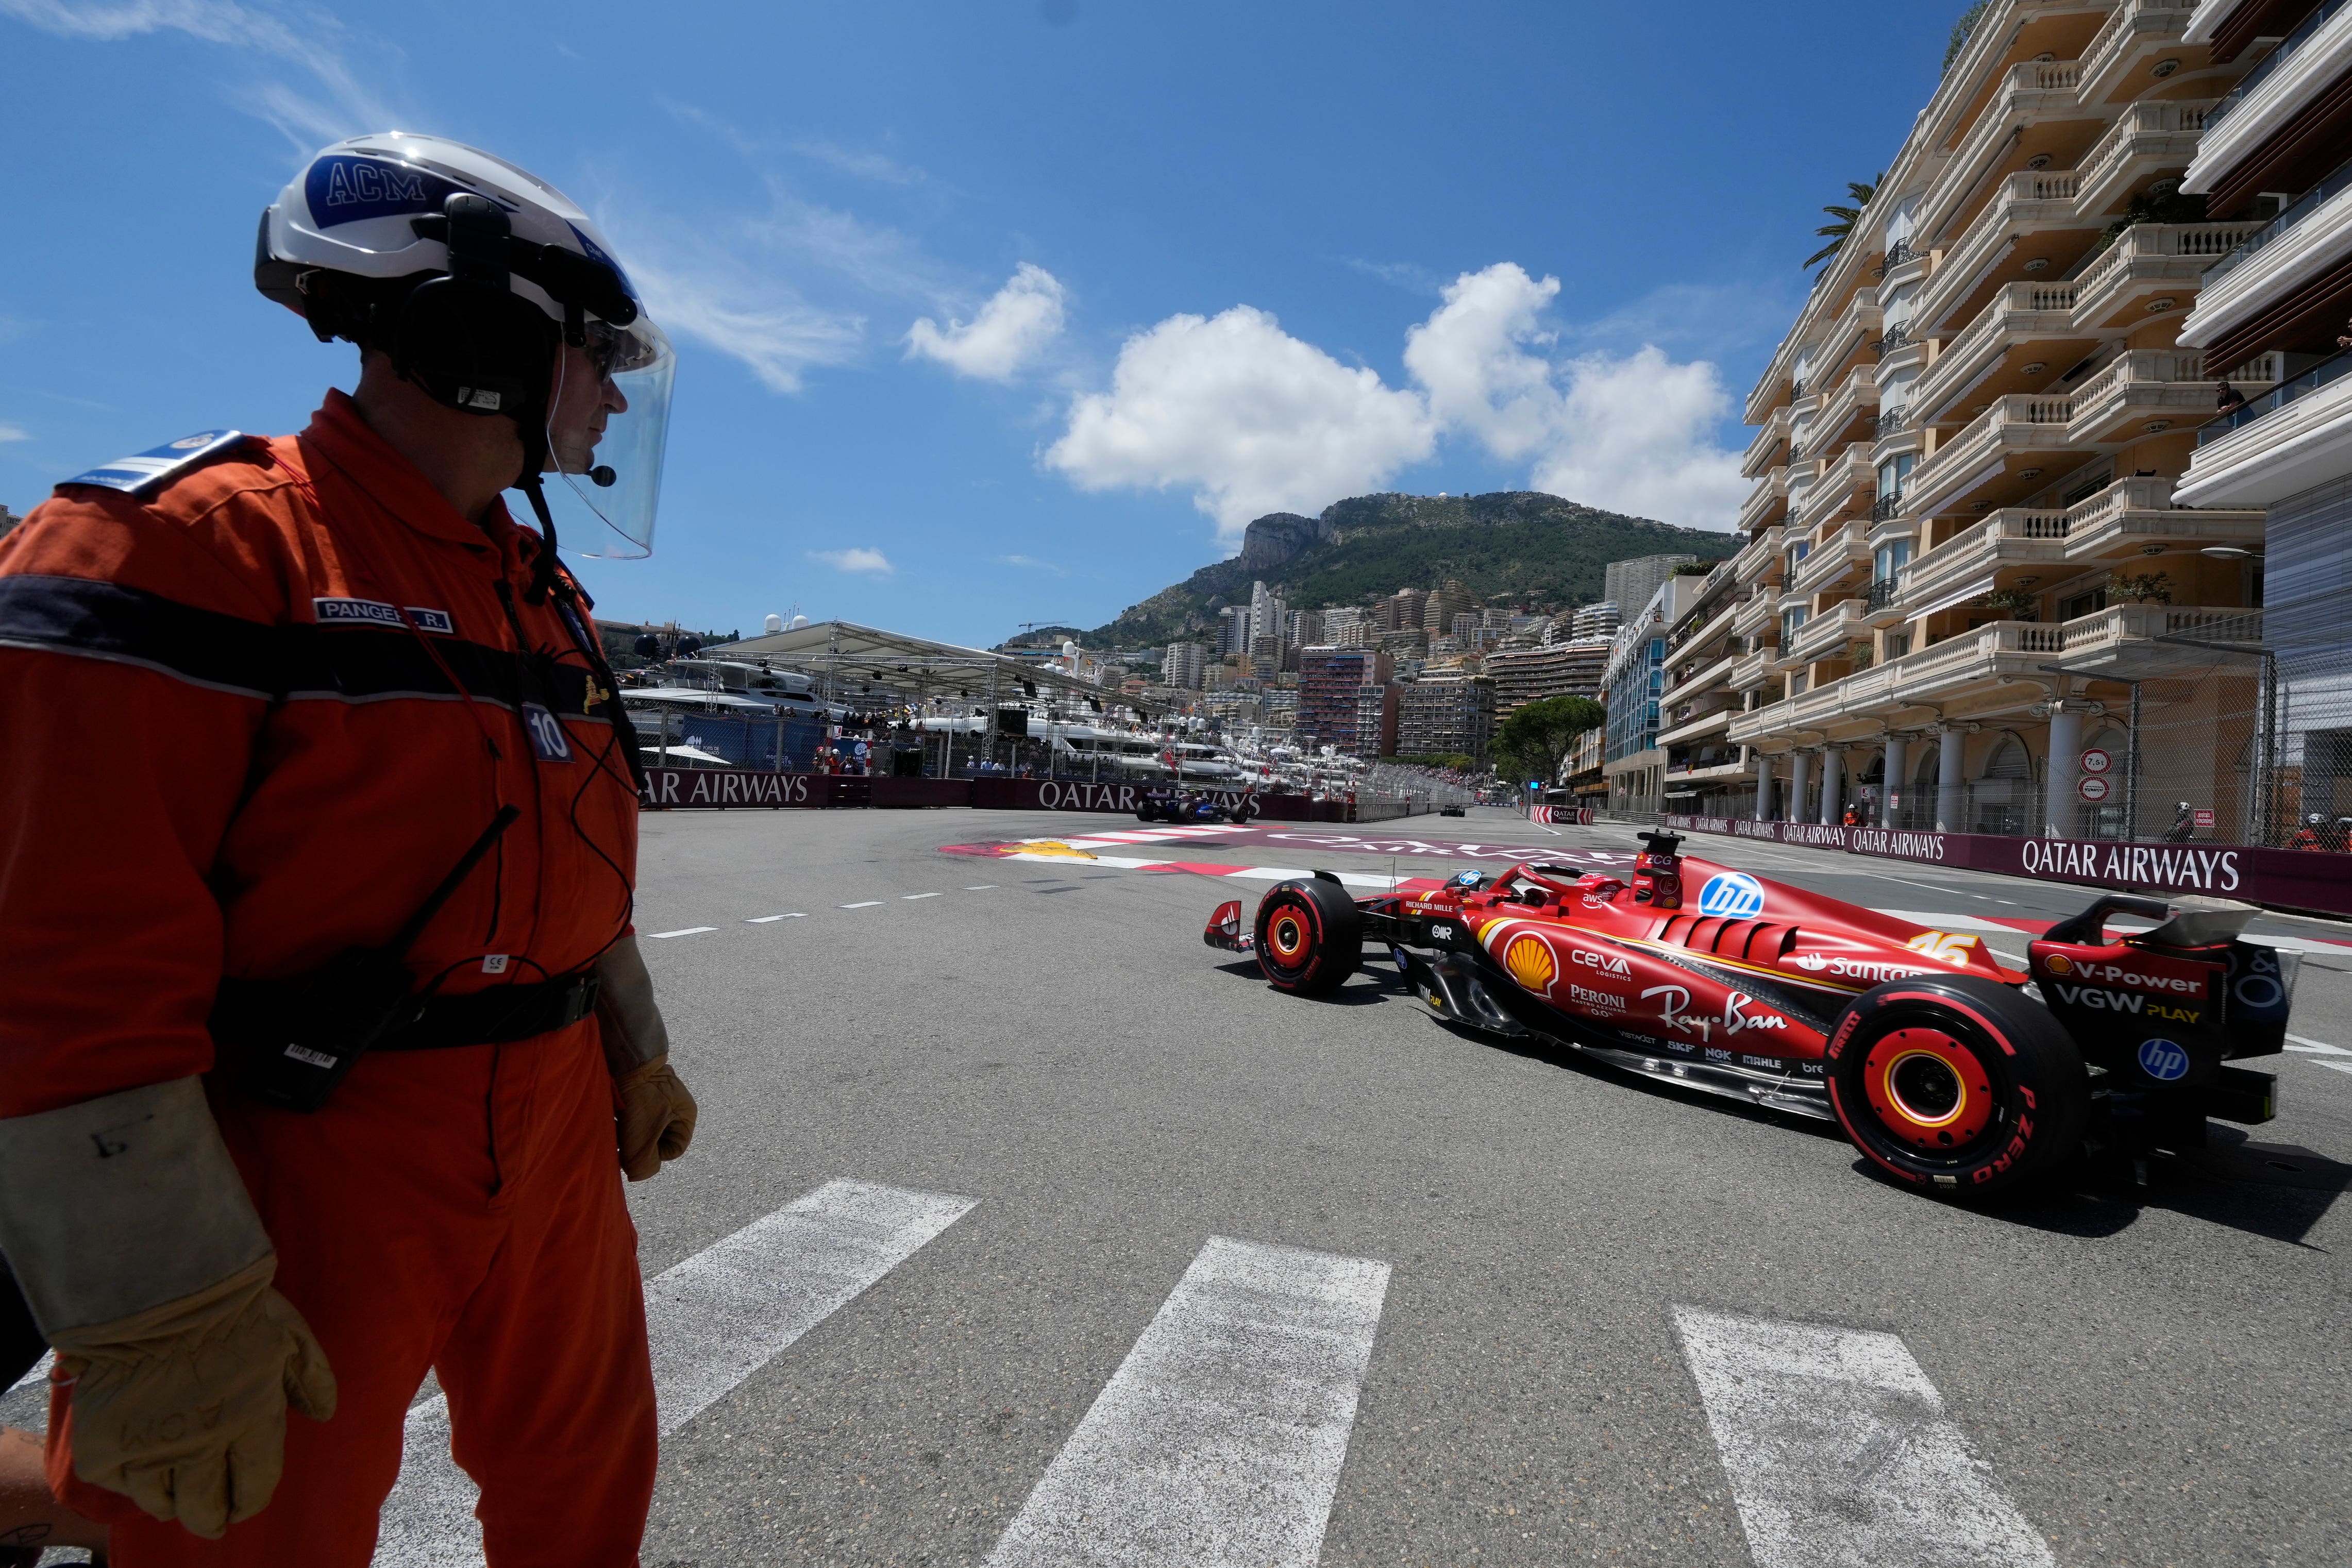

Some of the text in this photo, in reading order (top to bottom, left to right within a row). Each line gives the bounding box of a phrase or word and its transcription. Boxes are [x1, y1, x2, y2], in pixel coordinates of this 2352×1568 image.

[326, 162, 426, 206] ACM
[425, 614, 443, 627] R.
[531, 713, 567, 757] 10
[689, 773, 808, 803] AIRWAYS
[1038, 782, 1136, 810] QATAR
[1364, 804, 1381, 819] QATAR
[1667, 816, 1691, 829] QATAR AIRWAYS
[1695, 817, 1728, 833] QATAR AIRWAYS
[1735, 820, 1775, 839] QATAR AIRWAYS
[1783, 824, 1845, 846] QATAR AIRWAY
[1853, 829, 1944, 860] QATAR AIRWAYS
[1267, 834, 1637, 860] QATAR
[1328, 844, 1636, 865] AIRWAY
[1645, 854, 1673, 865] ZCG
[2022, 840, 2240, 891] QATAR AIRWAYS
[1463, 870, 1479, 884] hp
[1583, 893, 1603, 904] aws
[1704, 872, 1755, 918] hp
[1406, 901, 1453, 912] RICHARD MILLE
[1396, 949, 1405, 968] hp
[1903, 930, 1979, 967] 16
[1596, 970, 1631, 982] LOGISTICS
[2074, 962, 2202, 993] V-Power
[1430, 996, 1442, 1007] PLAY
[1571, 984, 1625, 1008] PERONI
[1571, 999, 1627, 1013] NASTRO AZZURRO
[2054, 983, 2201, 1024] VGW PLAY
[1827, 1010, 1862, 1060] PIRELLI
[1667, 1040, 1696, 1053] SKF
[1705, 1047, 1732, 1061] NGK
[1742, 1054, 1782, 1069] MAHLE
[2145, 1039, 2183, 1078] hp
[1972, 1084, 2037, 1185] P ZERO
